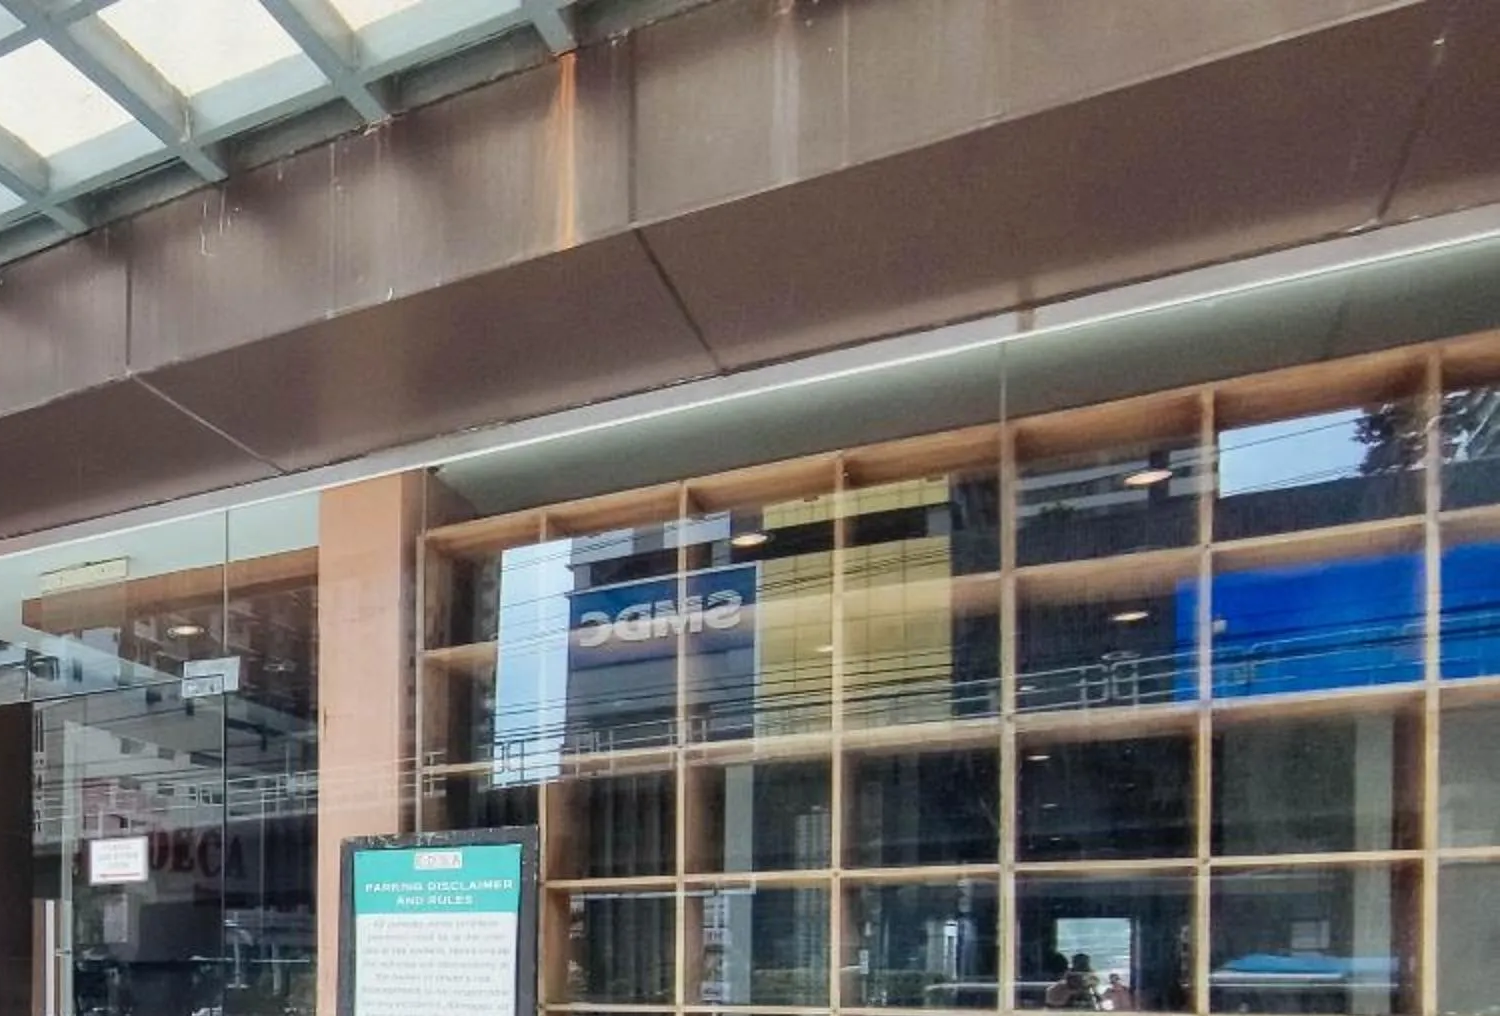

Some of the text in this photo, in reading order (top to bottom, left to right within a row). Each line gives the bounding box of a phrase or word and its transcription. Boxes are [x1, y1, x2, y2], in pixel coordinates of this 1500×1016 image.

[365, 880, 513, 893] PARKING DISCLAIMER
[396, 895, 474, 905] AND RULES
